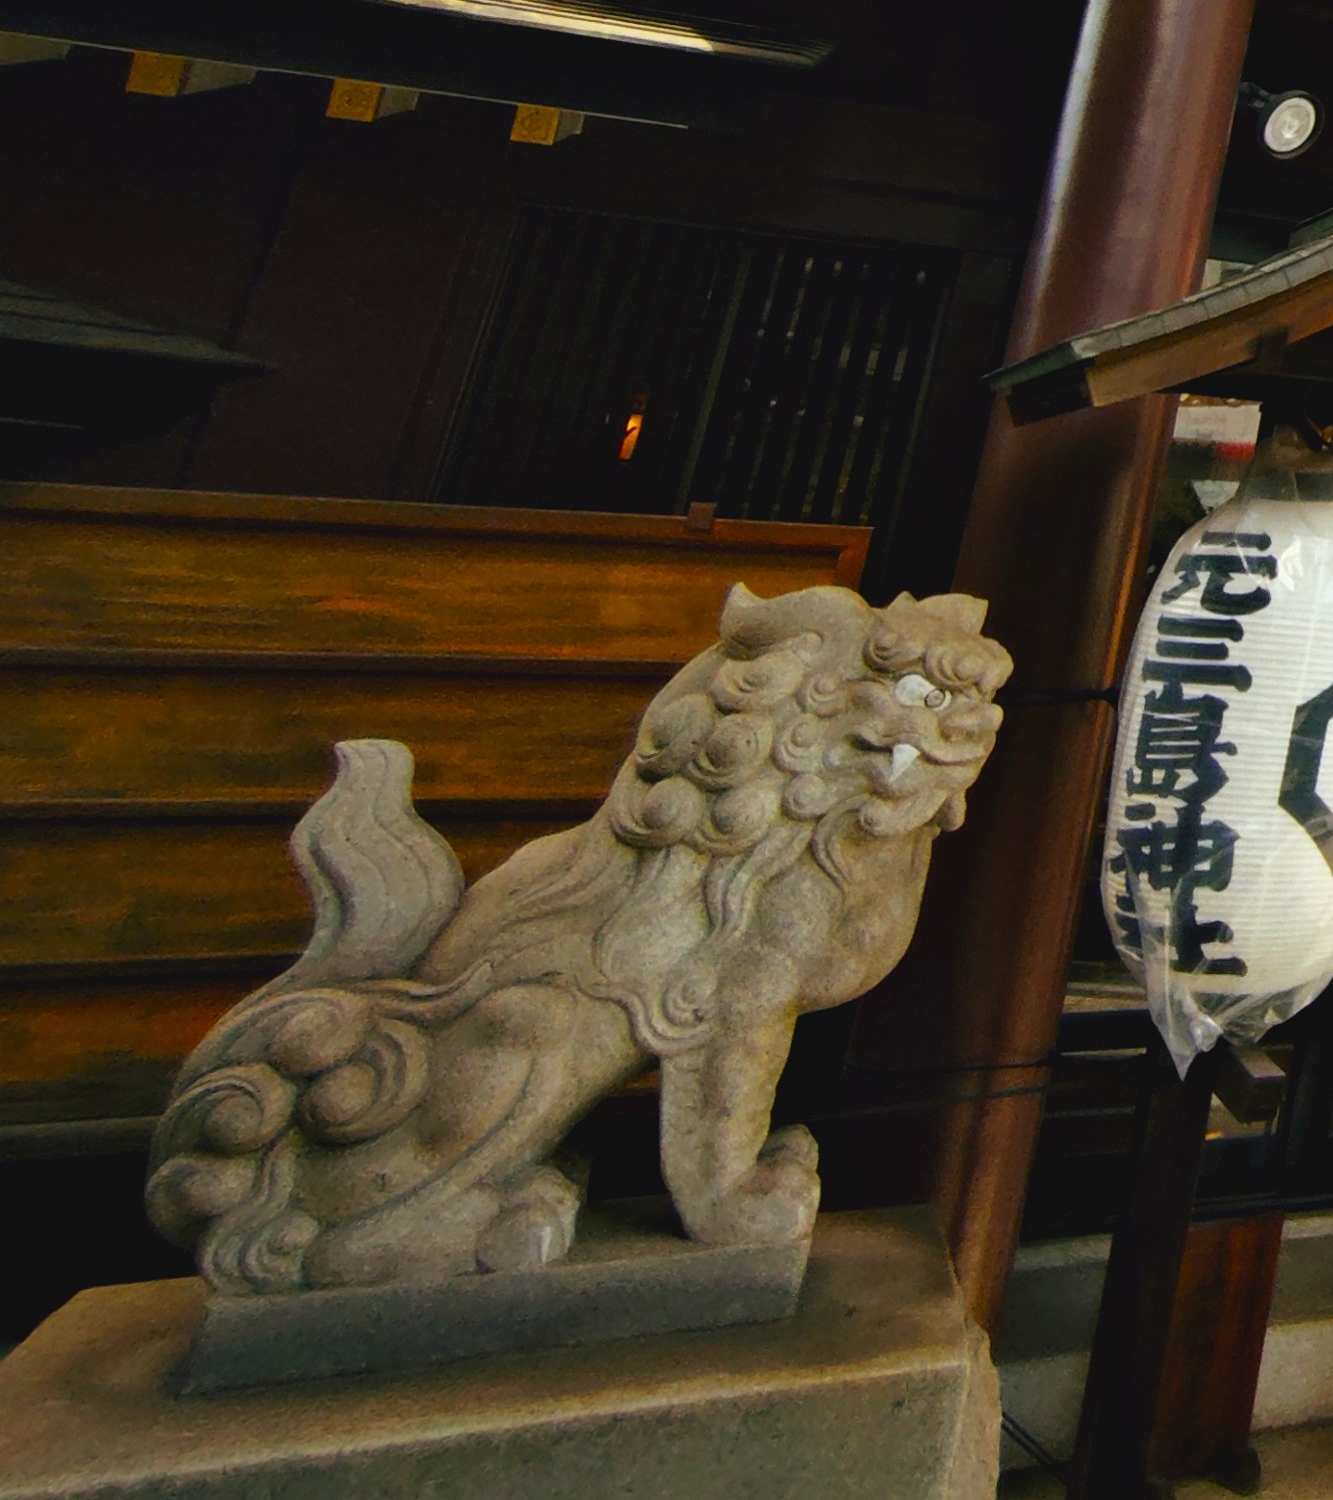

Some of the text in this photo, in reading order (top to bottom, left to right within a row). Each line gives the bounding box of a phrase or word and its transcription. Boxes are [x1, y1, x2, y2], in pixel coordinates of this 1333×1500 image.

[1110, 531, 1278, 976] 元三島神社
